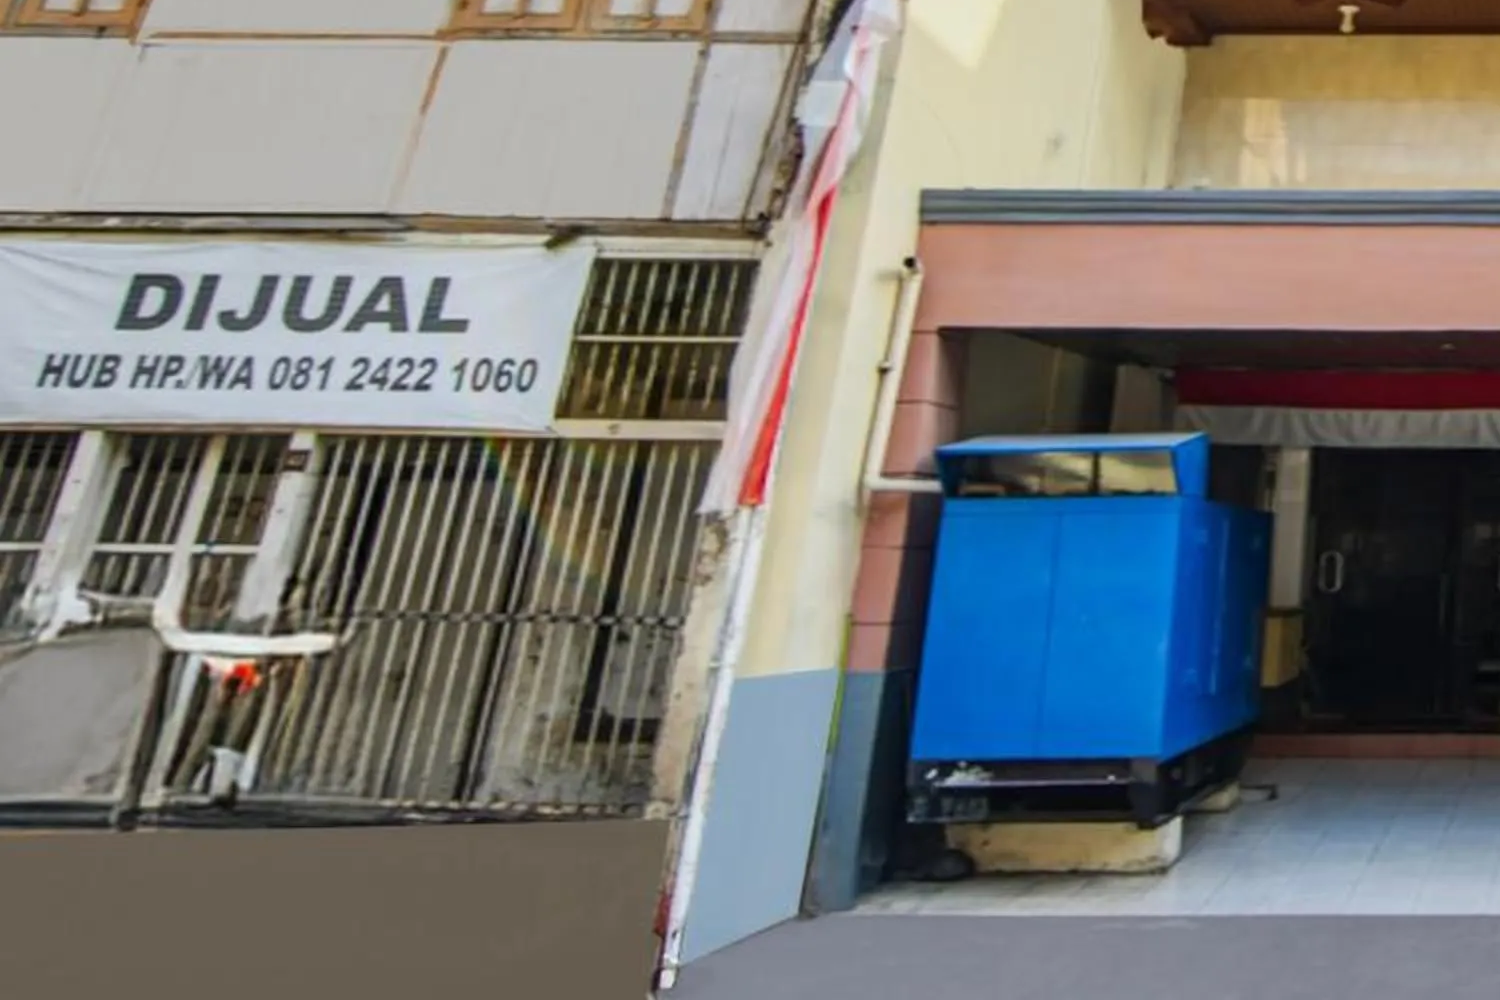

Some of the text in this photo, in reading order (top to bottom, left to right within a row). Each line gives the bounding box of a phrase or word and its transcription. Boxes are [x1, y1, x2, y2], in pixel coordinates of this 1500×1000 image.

[114, 273, 470, 333] DIJUAL
[36, 353, 122, 388] HUB
[268, 355, 334, 391] 081
[344, 357, 437, 392] 2422
[452, 358, 538, 393] 1060
